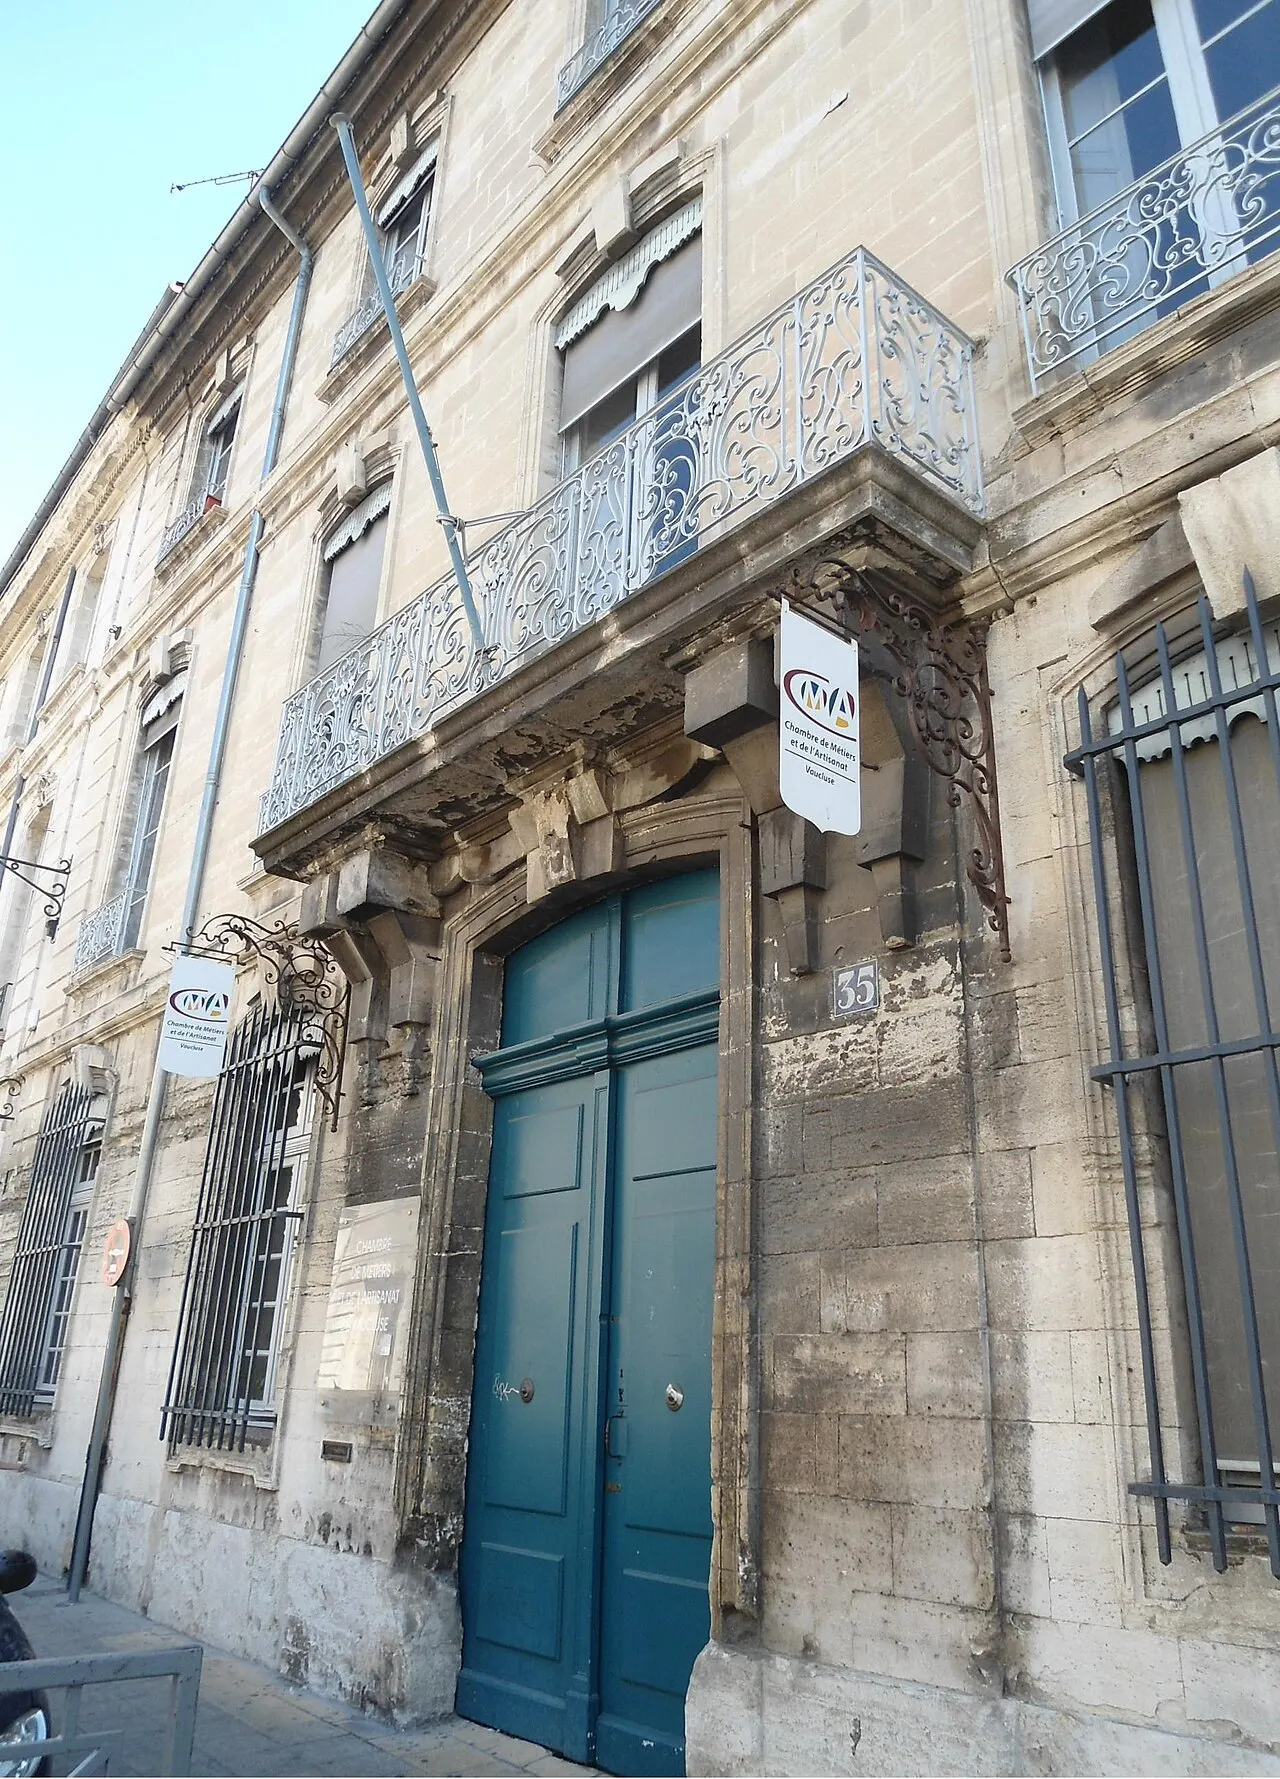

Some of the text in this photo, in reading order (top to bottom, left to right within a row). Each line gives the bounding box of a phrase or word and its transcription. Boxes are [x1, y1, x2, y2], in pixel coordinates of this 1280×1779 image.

[783, 669, 857, 742] CMA
[785, 720, 856, 762] Chambre de Métiers
[790, 739, 848, 772] et de l'Artisanat
[805, 764, 835, 786] Vaucluse
[838, 965, 875, 1009] 35
[169, 988, 229, 1023] CMA
[166, 1020, 225, 1035] Chambre de Métiers
[177, 1029, 186, 1037] de
[180, 1043, 204, 1052] Vaucluse
[356, 1237, 393, 1254] CHAMBRE
